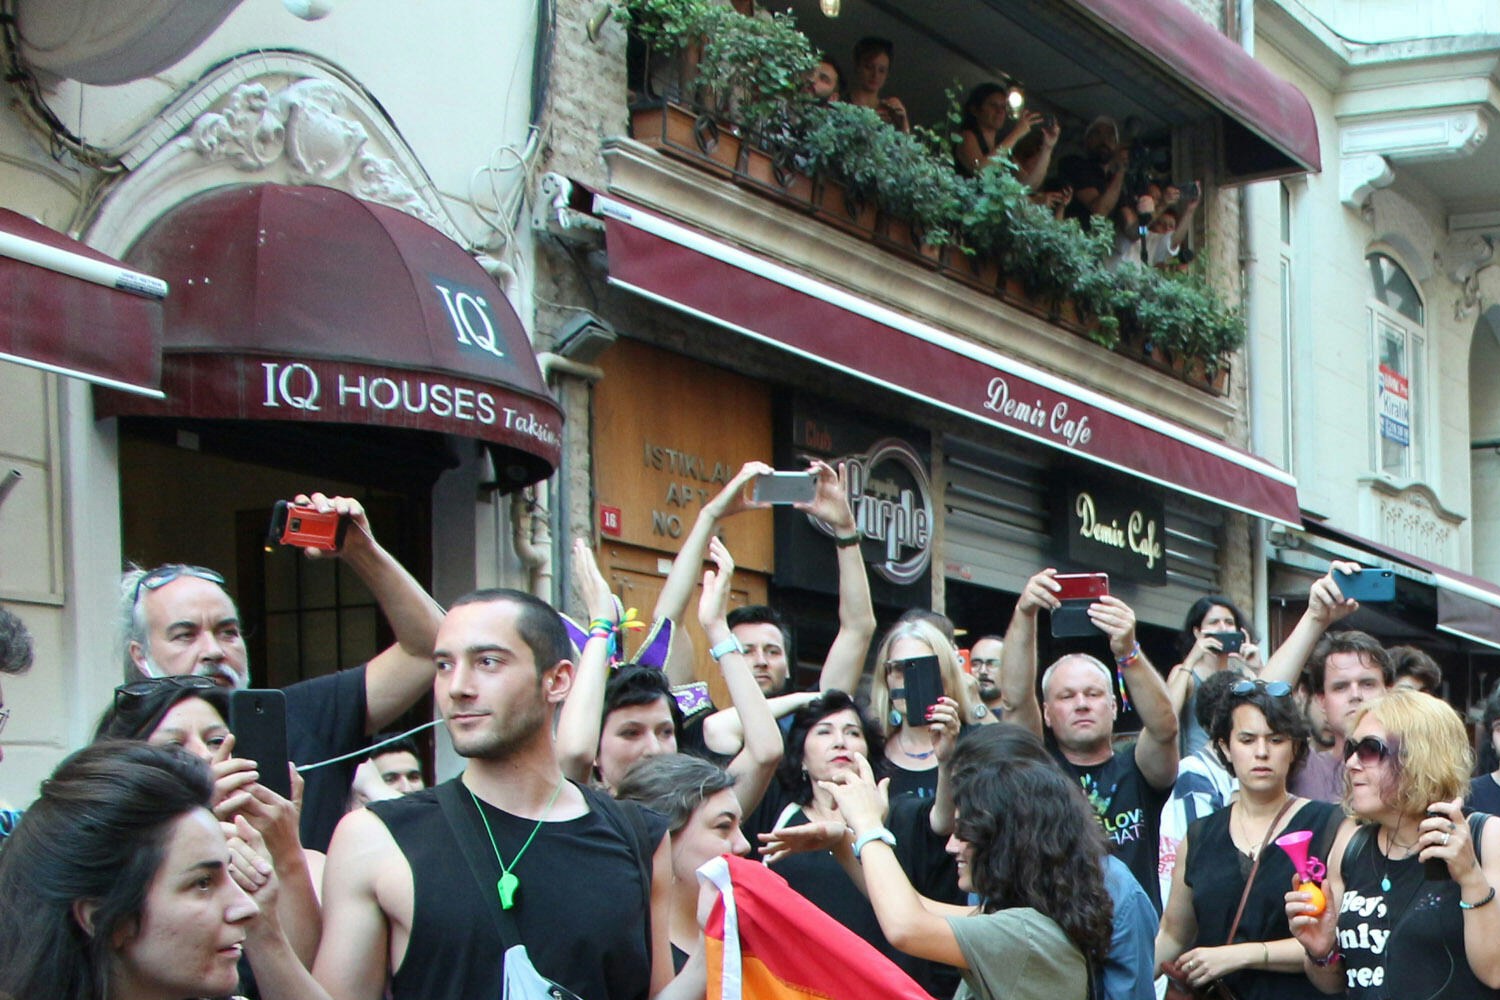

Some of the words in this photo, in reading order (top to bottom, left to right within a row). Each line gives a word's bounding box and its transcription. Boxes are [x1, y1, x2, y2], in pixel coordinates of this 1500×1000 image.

[435, 284, 504, 357] IQ
[261, 362, 321, 411] IQ
[338, 374, 497, 424] HOUSES
[983, 376, 1046, 428] Demir
[1050, 401, 1092, 447] Cafe
[652, 509, 681, 540] NO
[846, 458, 928, 561] Purple
[1076, 492, 1125, 548] Demir
[1128, 510, 1161, 569] Cafe
[1339, 890, 1387, 918] Hey,
[1335, 923, 1391, 954] nly
[1346, 966, 1385, 988] ree
